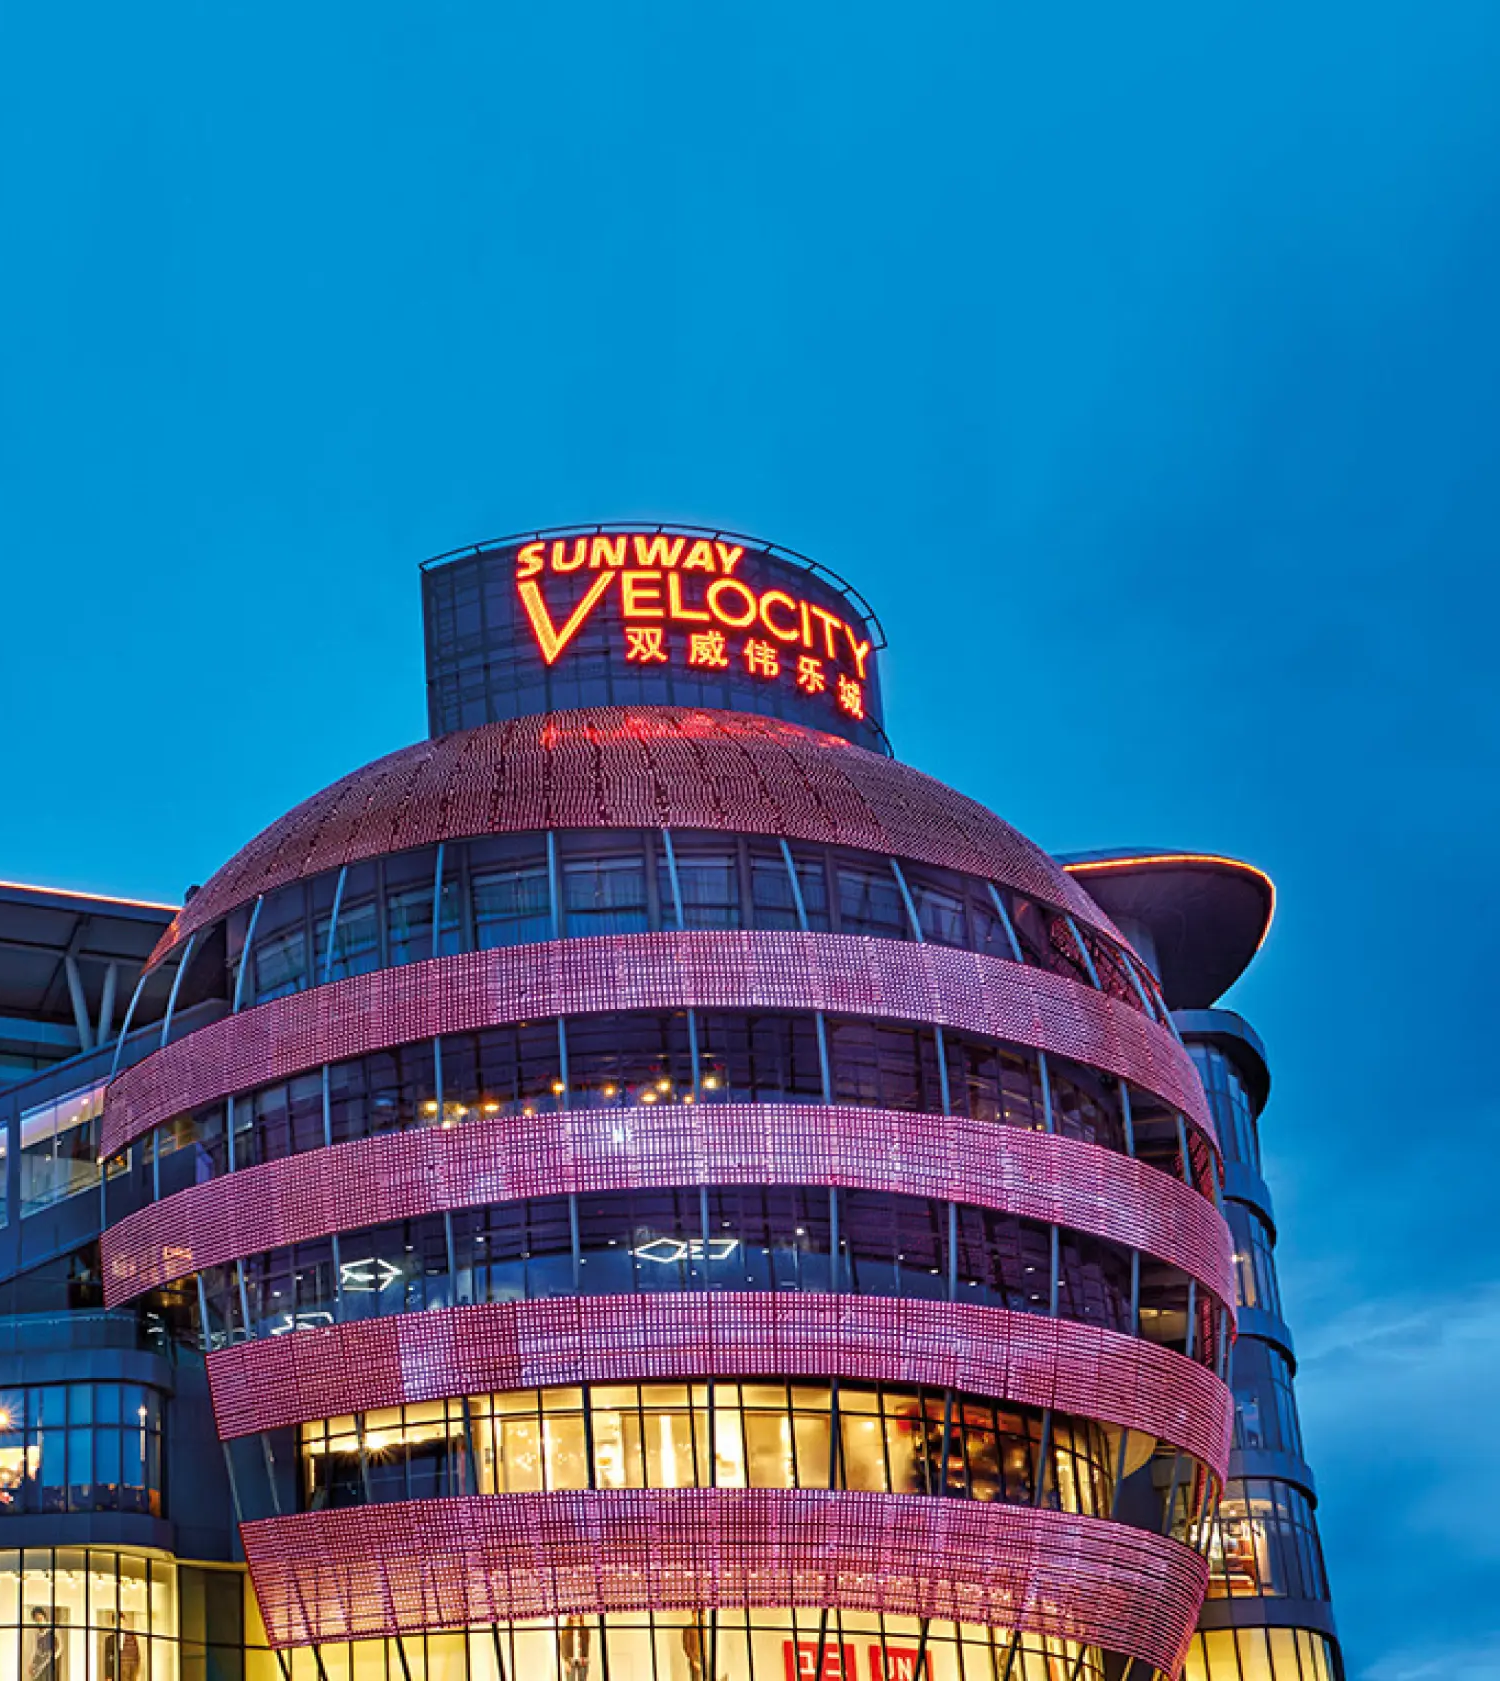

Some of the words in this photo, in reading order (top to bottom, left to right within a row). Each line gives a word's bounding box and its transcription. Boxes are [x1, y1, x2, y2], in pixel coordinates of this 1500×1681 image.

[516, 536, 744, 577] SUNWAY
[517, 569, 870, 679] VELOCITY
[625, 626, 865, 720] 双威伟乐城
